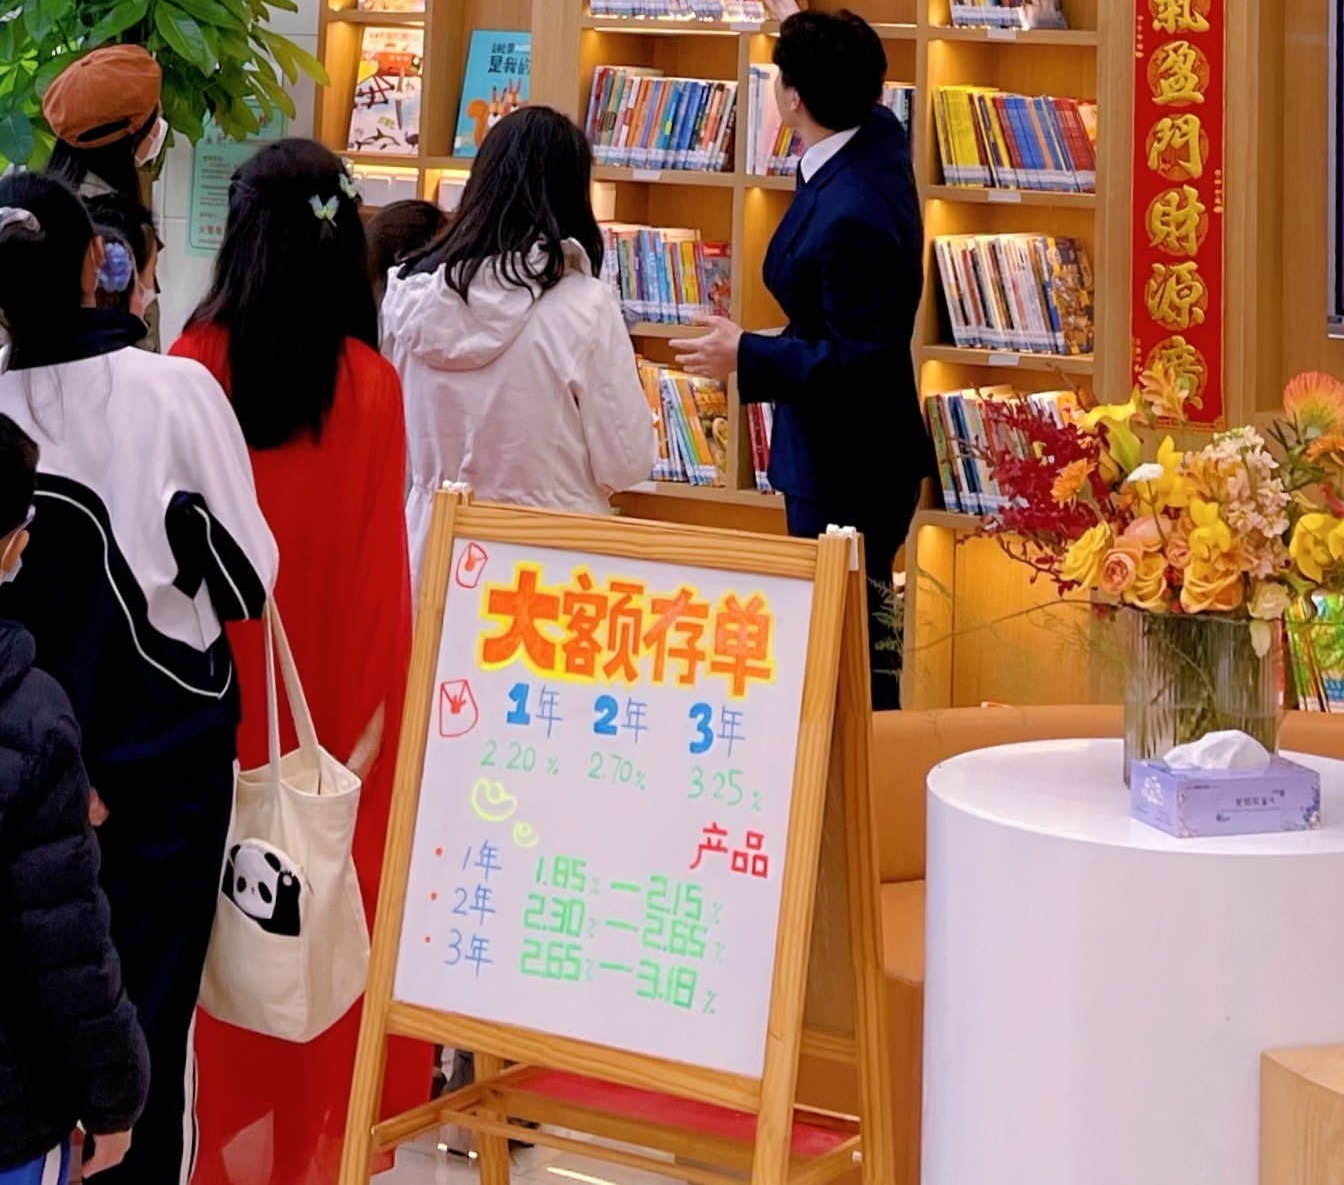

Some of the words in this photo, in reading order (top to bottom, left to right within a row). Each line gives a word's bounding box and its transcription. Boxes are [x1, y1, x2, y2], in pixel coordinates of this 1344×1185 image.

[478, 566, 773, 699] 大额存单
[505, 683, 564, 738] 1年
[593, 694, 649, 746] 2年
[688, 702, 746, 757] 3年
[461, 839, 502, 877] 1年
[689, 821, 770, 879] 产品
[452, 883, 497, 926] 2年
[444, 928, 494, 976] 3年
